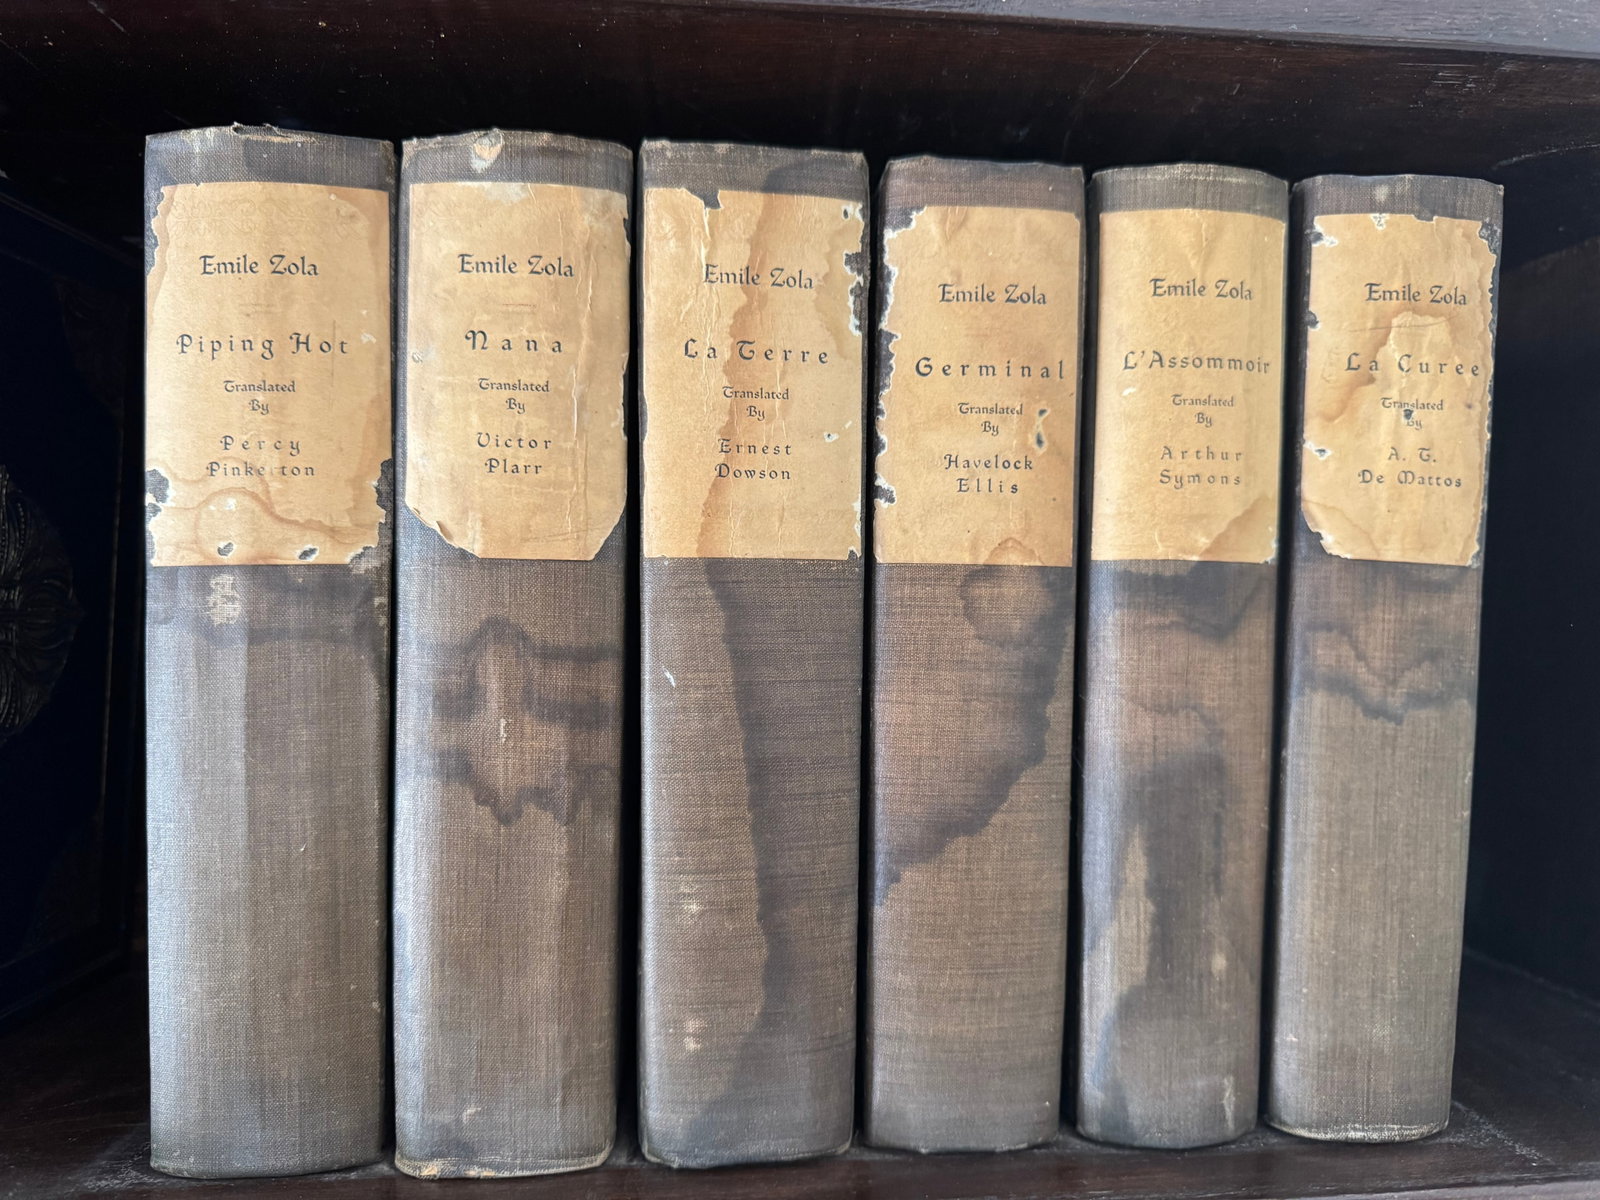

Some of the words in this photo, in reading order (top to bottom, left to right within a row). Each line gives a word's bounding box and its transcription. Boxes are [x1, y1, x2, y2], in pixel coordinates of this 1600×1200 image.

[200, 254, 259, 276] Emile
[269, 255, 319, 276] Zola
[458, 254, 518, 274] Emile
[528, 255, 575, 277] Zola
[704, 264, 760, 285] Emile
[770, 267, 814, 289] Zola
[938, 283, 996, 303] Emile
[1005, 284, 1047, 305] Zola
[1150, 278, 1206, 297] Emile
[1215, 279, 1253, 300] Zola
[1364, 283, 1421, 303] Emile
[1429, 285, 1467, 305] Zola
[176, 334, 274, 360] Piping
[290, 332, 348, 354] Hot
[465, 330, 562, 353] Nana
[684, 338, 717, 359] La
[737, 340, 828, 364] Terre
[915, 357, 1064, 380] Germinal
[1123, 351, 1270, 374] L'Assommoir
[1345, 353, 1379, 371] La
[1398, 354, 1479, 376] Curee
[223, 380, 296, 392] Translated
[478, 378, 550, 392] Translated
[722, 386, 789, 400] Translated
[249, 400, 269, 415] By
[506, 398, 525, 414] By
[1171, 394, 1234, 407] Translated
[1381, 397, 1444, 410] Translated
[746, 406, 765, 421] By
[958, 403, 1023, 415] Translated
[1195, 412, 1213, 427] By
[981, 421, 999, 436] By
[220, 435, 300, 456] Percy
[477, 432, 552, 449] Victor
[718, 439, 791, 455] Ernest
[1161, 446, 1242, 461] Arthur
[1388, 447, 1406, 461] A.
[1418, 448, 1437, 462] T.
[484, 458, 542, 474] Plarr
[944, 454, 1033, 470] Havelock
[715, 463, 791, 480] Dowson
[1159, 469, 1241, 489] Symons
[1358, 469, 1385, 484] De
[1397, 471, 1462, 488] Mattos
[956, 478, 1019, 494] Ellis
